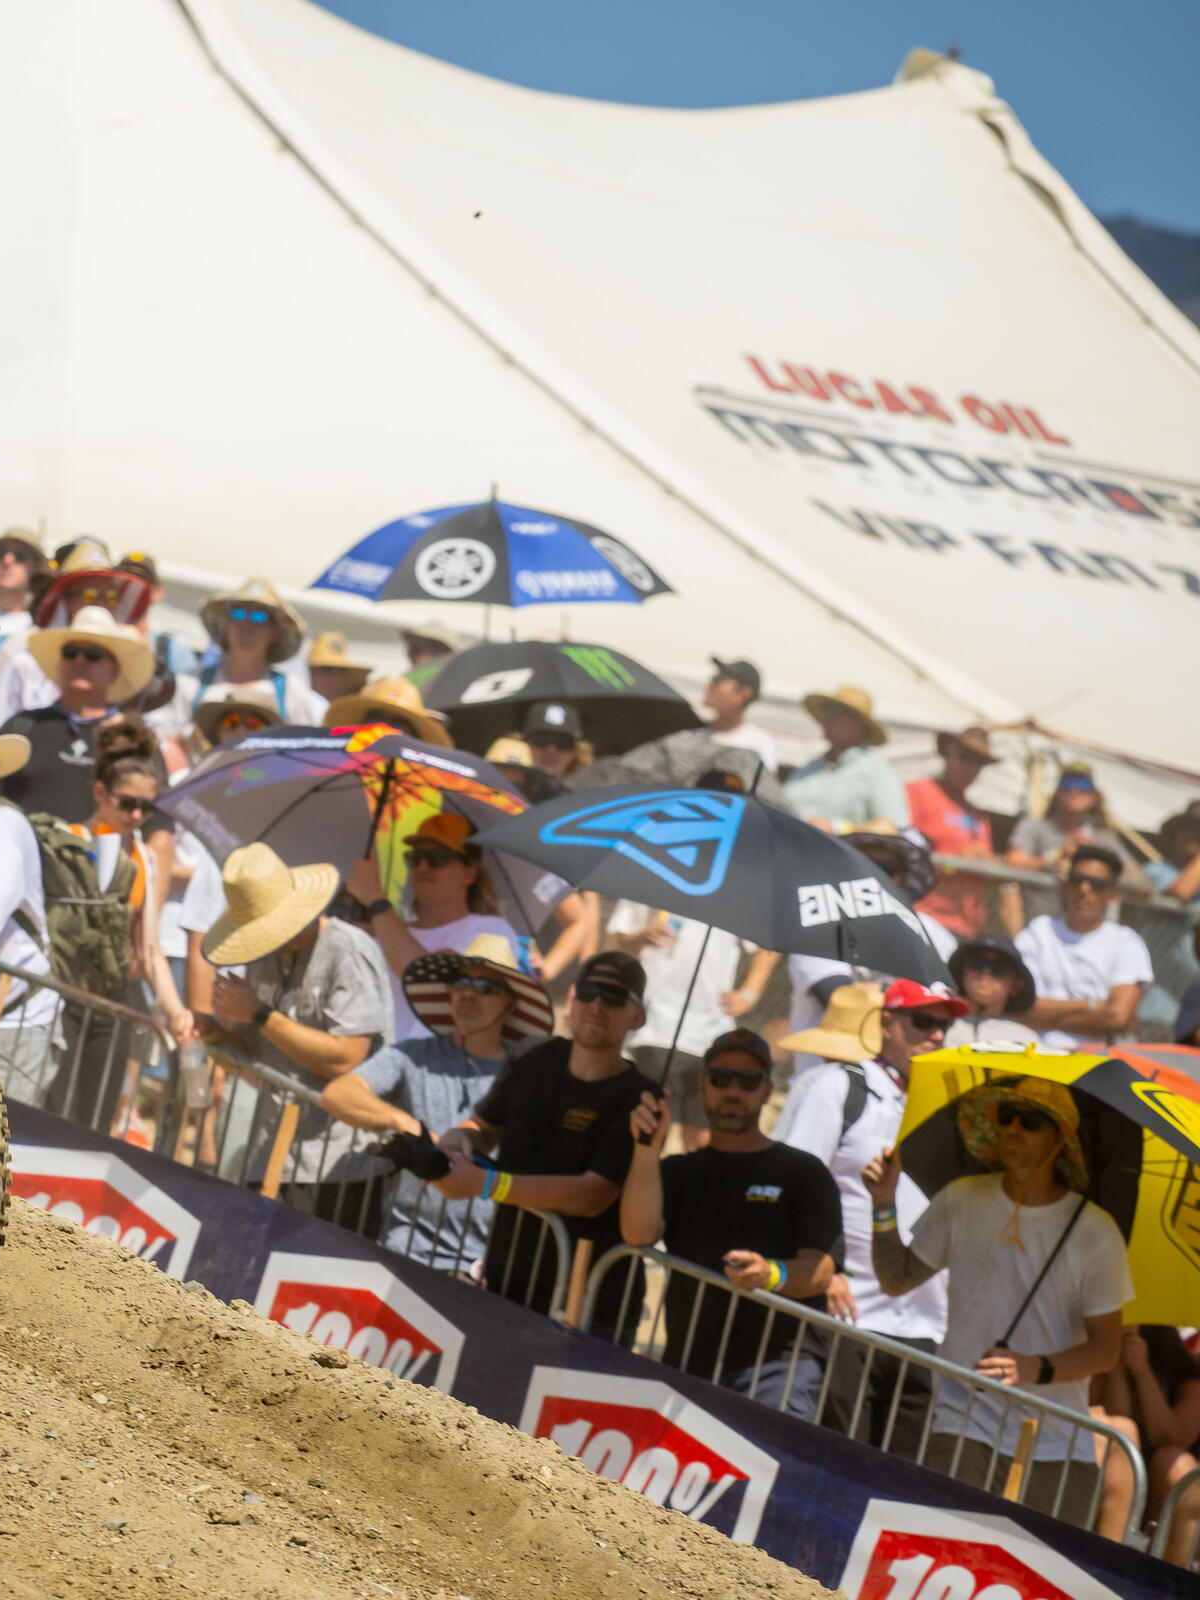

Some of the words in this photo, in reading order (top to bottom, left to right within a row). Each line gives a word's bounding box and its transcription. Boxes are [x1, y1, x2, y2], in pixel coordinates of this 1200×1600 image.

[744, 354, 955, 424] LUCAS
[958, 396, 1071, 446] OIL
[700, 403, 1200, 529] MOTOCROS
[810, 498, 961, 552] VIP
